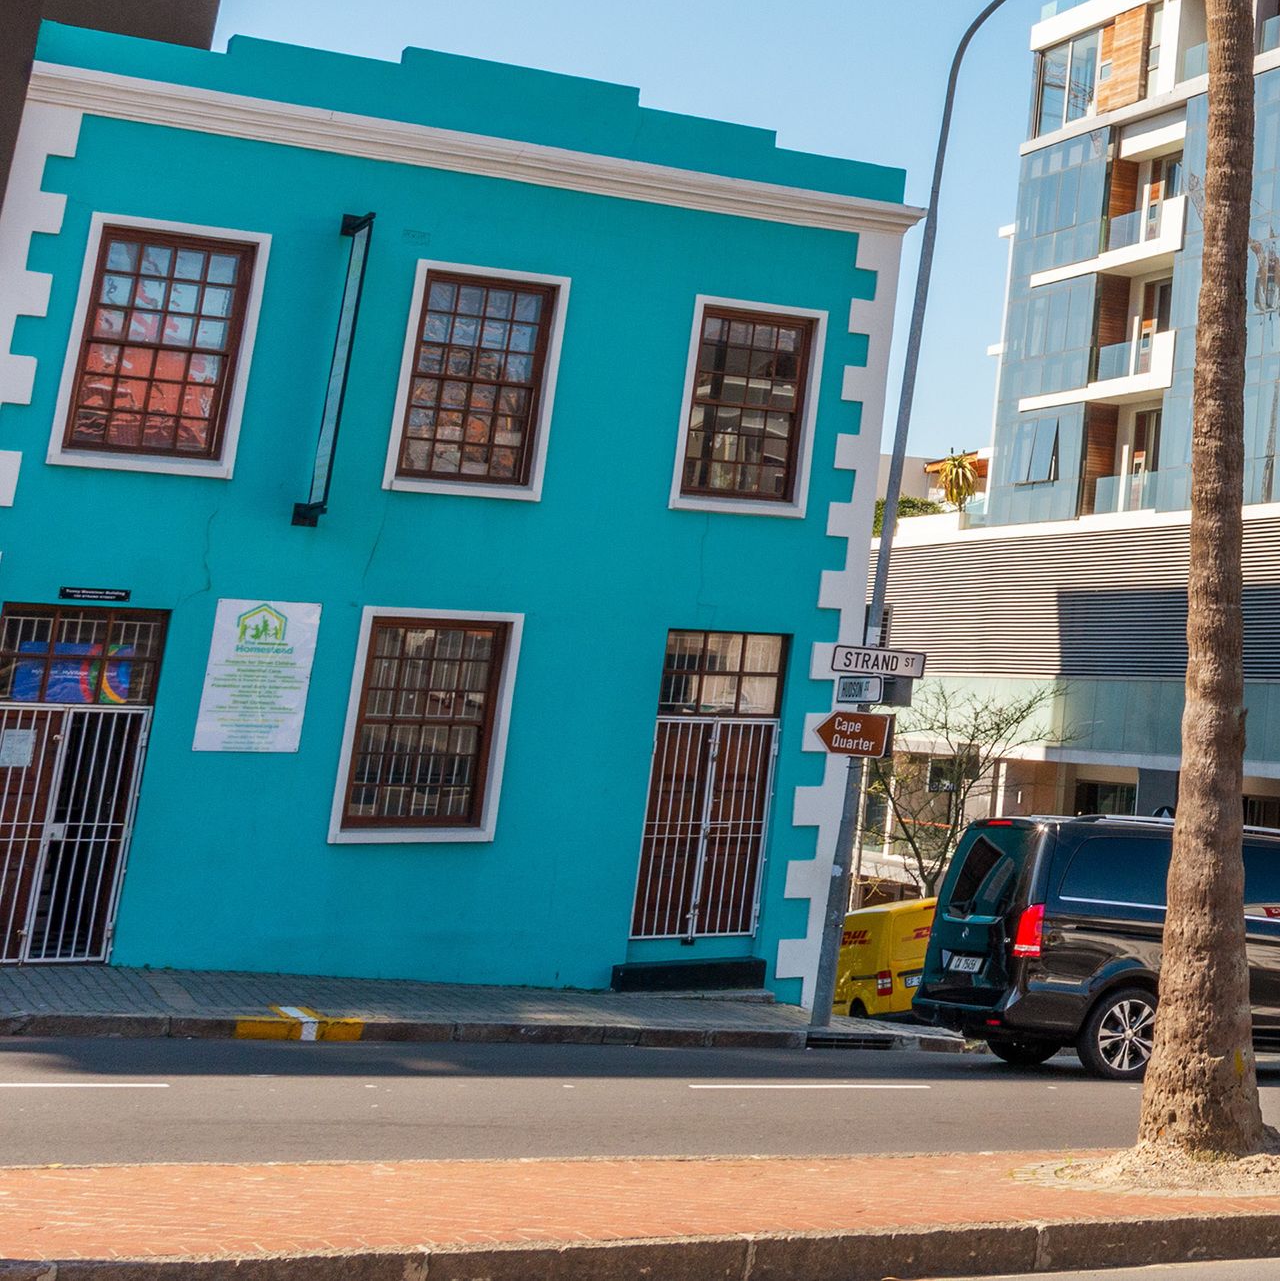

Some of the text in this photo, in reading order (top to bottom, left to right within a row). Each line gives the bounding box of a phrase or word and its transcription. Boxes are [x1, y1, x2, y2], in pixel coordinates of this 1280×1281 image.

[843, 651, 916, 672] STRAND ST
[840, 681, 863, 698] HUDSON
[834, 716, 862, 735] Cape
[831, 733, 876, 752] Quarter
